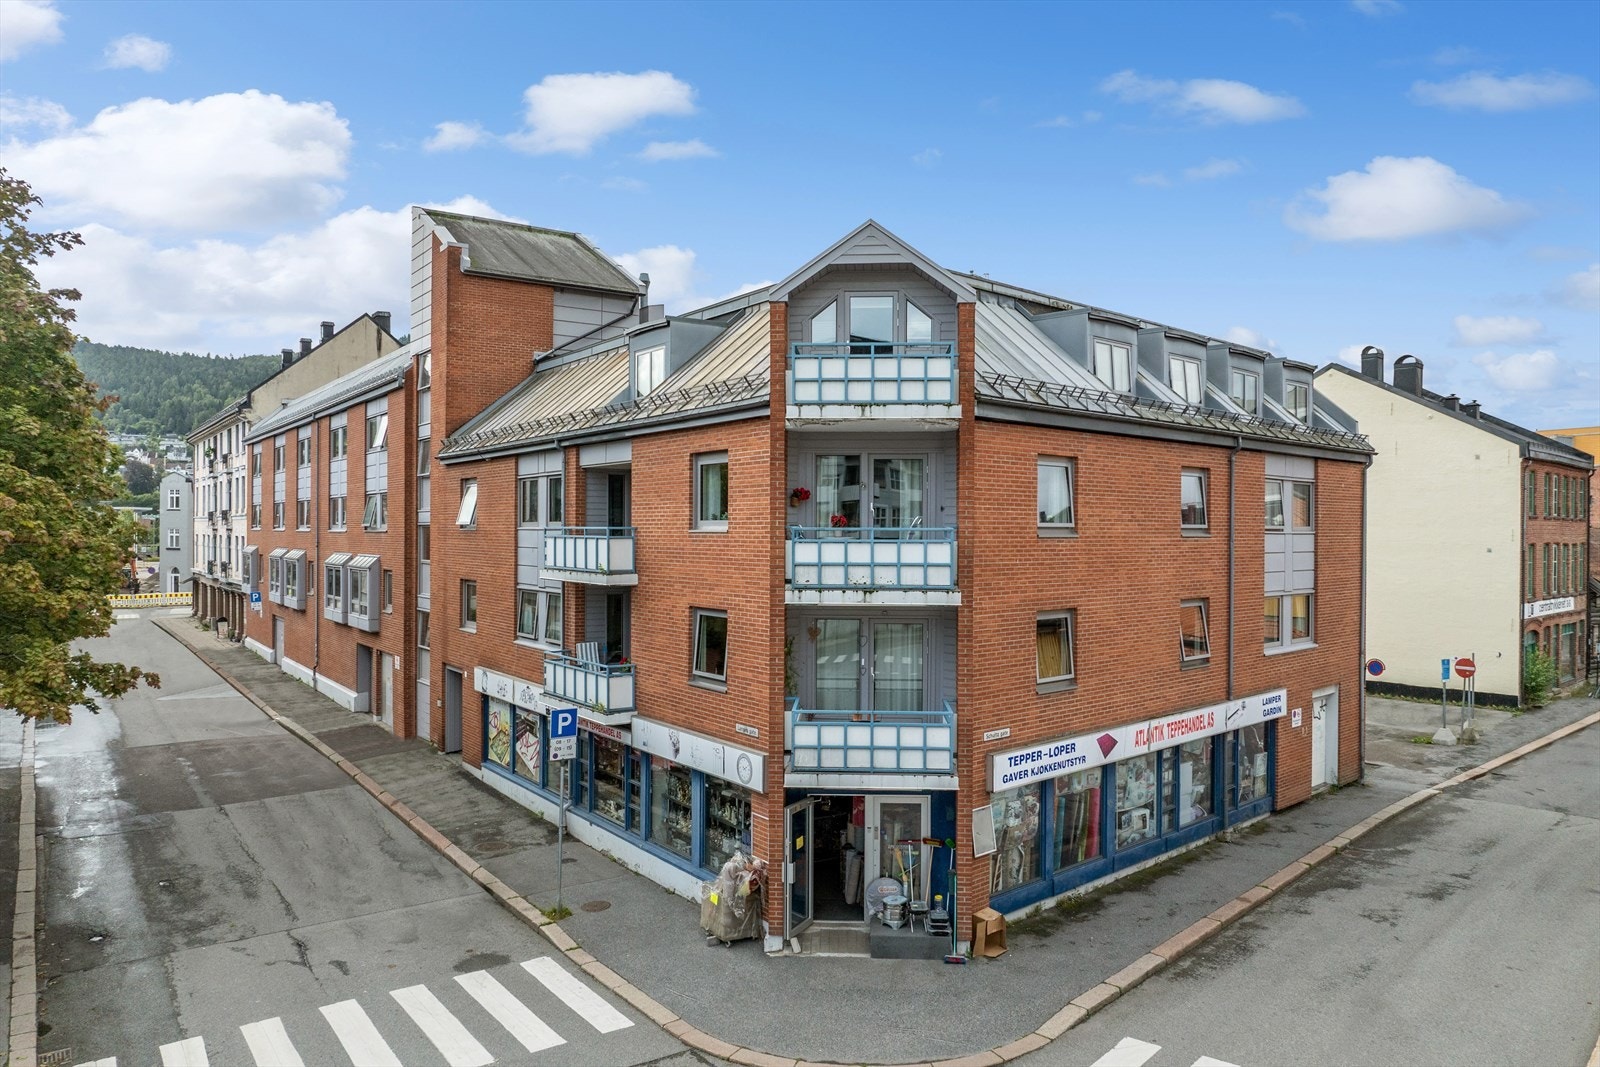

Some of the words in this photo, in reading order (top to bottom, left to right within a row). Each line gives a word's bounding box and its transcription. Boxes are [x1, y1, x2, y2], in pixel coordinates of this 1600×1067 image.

[252, 593, 258, 602] P
[1262, 694, 1281, 706] LAMPER
[558, 713, 572, 734] P
[1167, 714, 1206, 739] TEPPEHANDEL
[1207, 712, 1214, 728] AS
[616, 730, 622, 740] AS
[1002, 770, 1028, 783] GAVER
